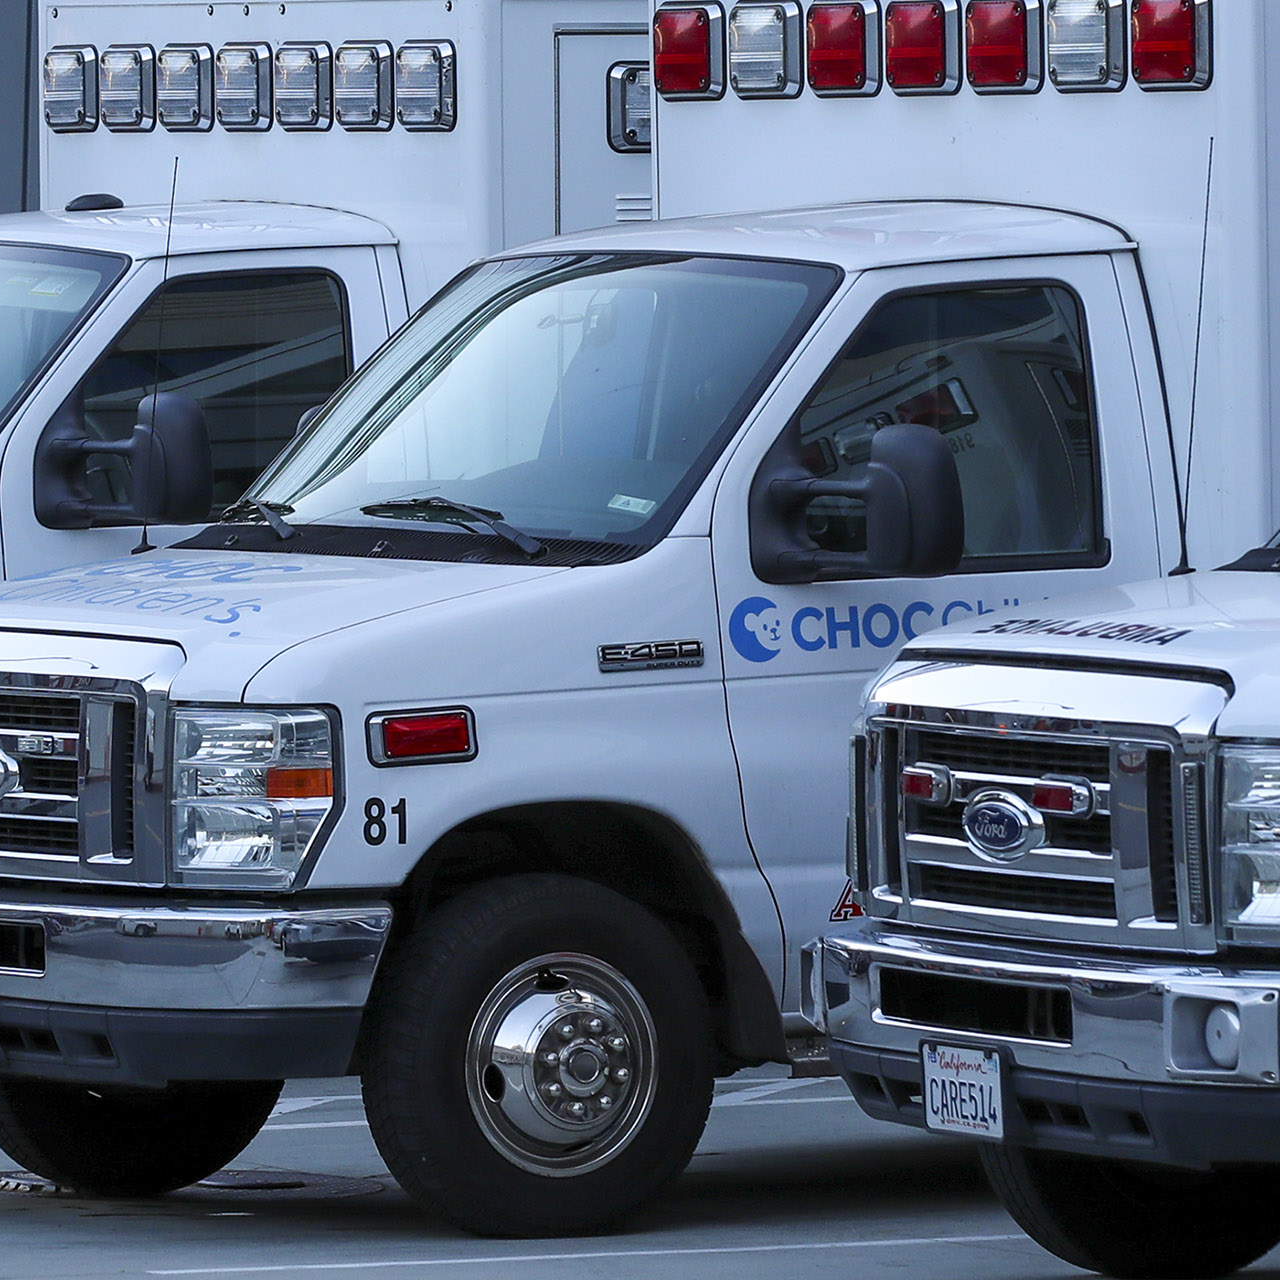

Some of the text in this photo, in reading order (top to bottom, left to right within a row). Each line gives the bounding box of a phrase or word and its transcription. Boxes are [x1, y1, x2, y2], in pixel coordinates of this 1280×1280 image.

[791, 600, 935, 651] CHOC
[601, 641, 702, 661] E-450
[363, 797, 407, 846] 81
[937, 1050, 988, 1077] California
[929, 1077, 998, 1125] CARE514
